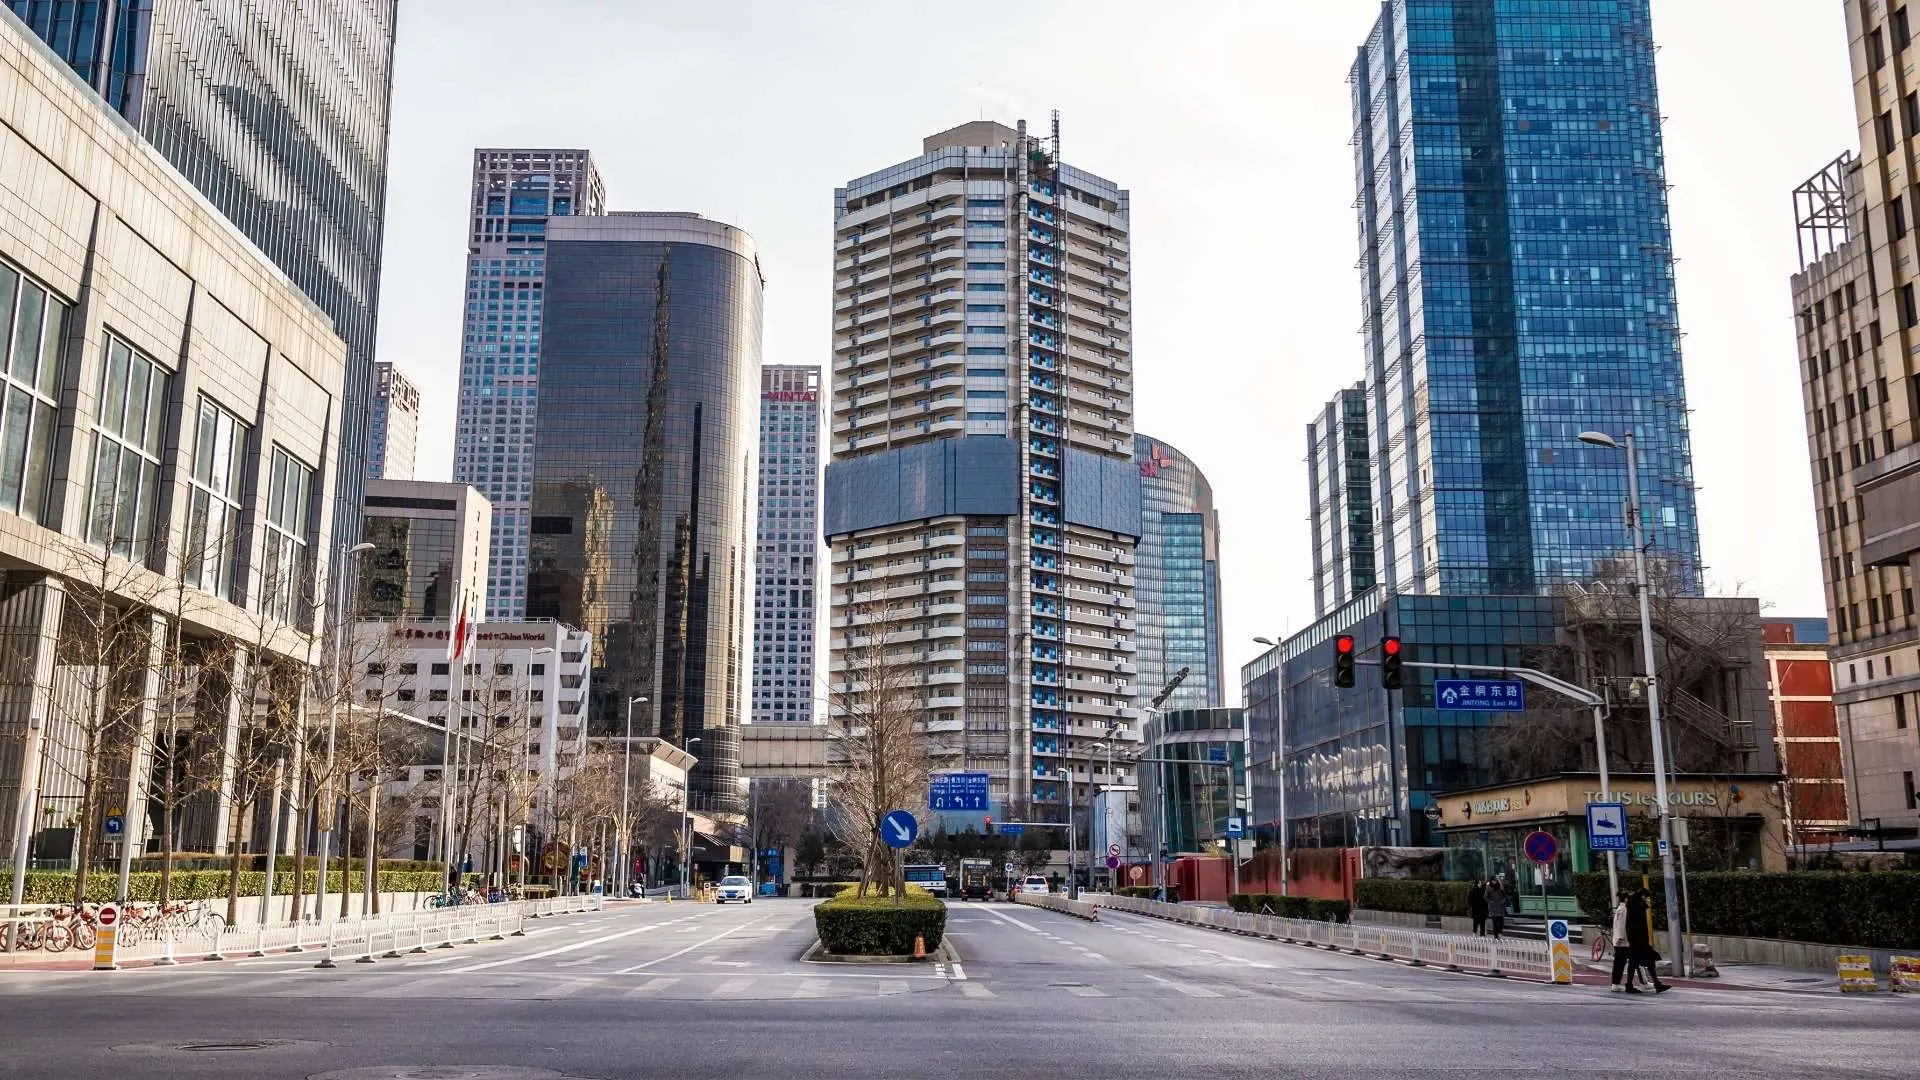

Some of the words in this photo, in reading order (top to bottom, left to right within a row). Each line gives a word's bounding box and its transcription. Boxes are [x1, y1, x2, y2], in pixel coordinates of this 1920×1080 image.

[1459, 684, 1517, 697] 金桐东路
[1461, 699, 1490, 707] JINTONG
[1492, 699, 1506, 707] East
[1583, 791, 1632, 806] TOUS
[1667, 791, 1718, 806] OURS
